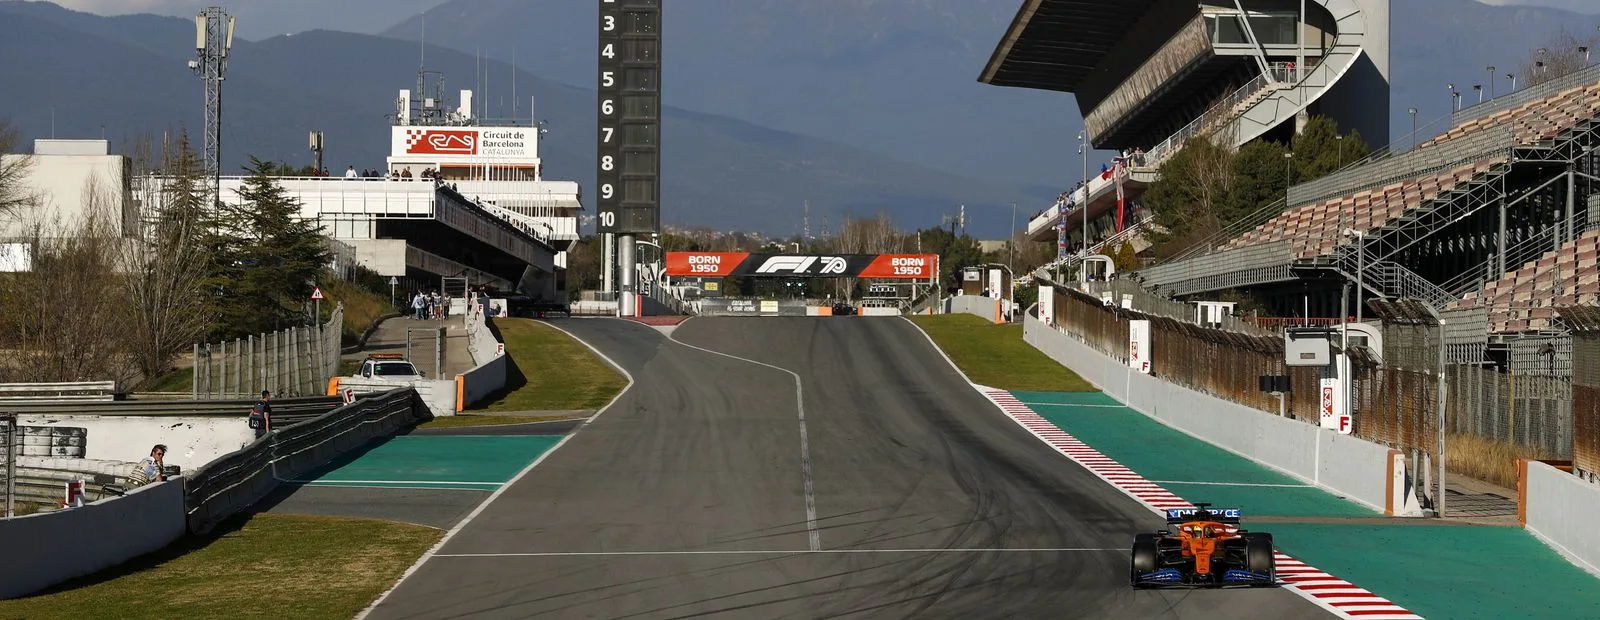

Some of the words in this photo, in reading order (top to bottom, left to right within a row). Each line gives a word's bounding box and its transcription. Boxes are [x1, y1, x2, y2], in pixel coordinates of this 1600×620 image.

[603, 15, 615, 31] 3
[602, 43, 615, 59] 4
[602, 71, 614, 87] 5
[602, 99, 614, 115] 6
[483, 131, 512, 139] Circuit
[513, 131, 525, 139] de
[602, 127, 614, 143] 7
[482, 140, 524, 148] Barcelona
[601, 155, 614, 171] 8
[601, 183, 614, 199] 9
[599, 211, 615, 227] 10
[688, 255, 721, 264] BORN
[891, 257, 924, 267] BORN
[690, 264, 719, 273] 1950
[894, 267, 922, 275] 1950
[1045, 316, 1051, 325] F
[498, 344, 503, 352] F
[1142, 361, 1149, 371] F
[346, 388, 353, 403] F
[1339, 416, 1350, 432] F
[69, 482, 82, 504] F
